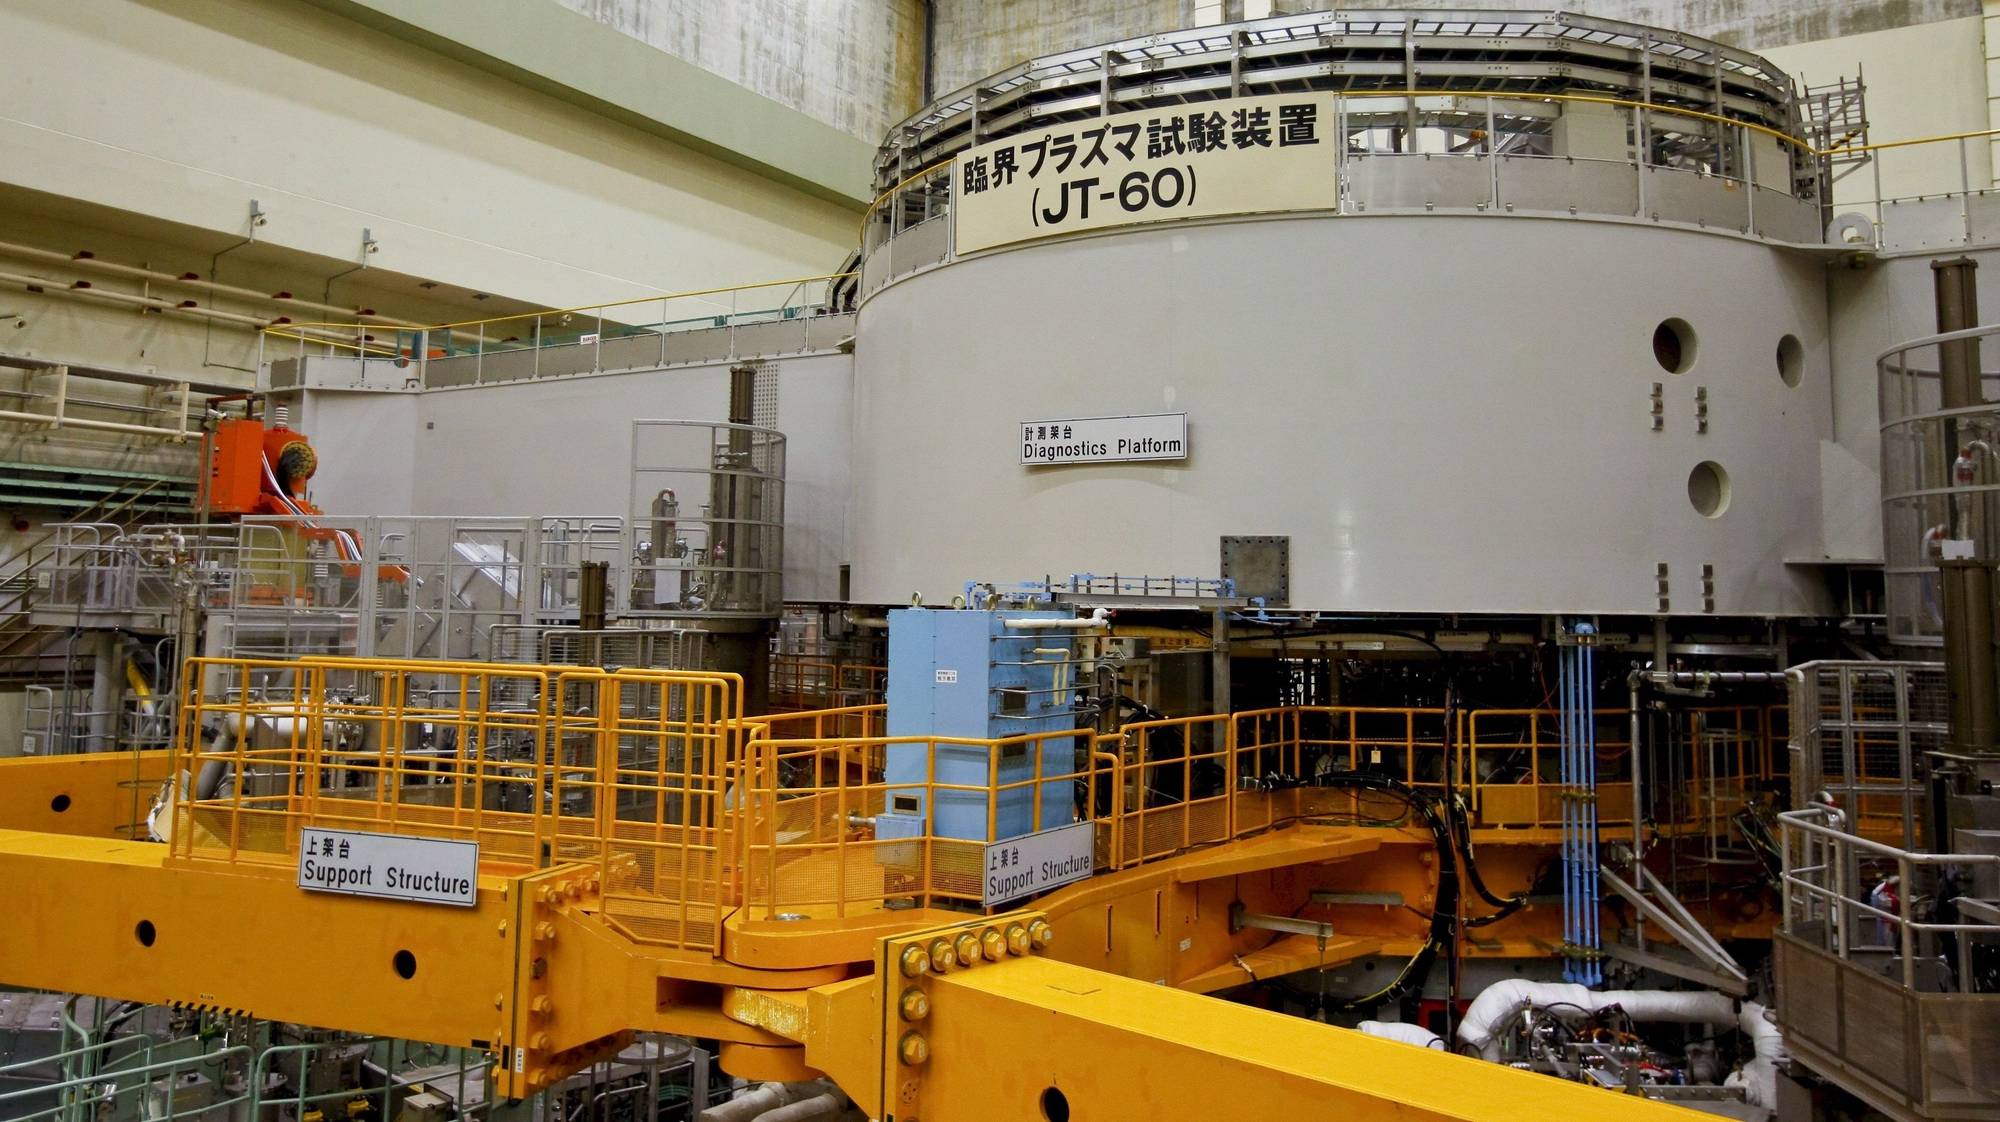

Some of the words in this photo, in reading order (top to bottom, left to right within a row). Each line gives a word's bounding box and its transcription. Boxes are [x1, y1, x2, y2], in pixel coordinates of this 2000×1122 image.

[964, 103, 1320, 195] 臨界プラズマ試験装置
[1032, 165, 1197, 227] (JT-60)
[1024, 425, 1072, 441] 計測架台
[1024, 441, 1107, 461] Diagnostics
[1118, 438, 1181, 454] Platform
[306, 836, 350, 859] 上架台
[990, 845, 1019, 871] 上架台
[304, 859, 372, 888] Support
[386, 867, 470, 895] Structure
[989, 865, 1034, 897] Support
[1042, 855, 1090, 881] Structure
